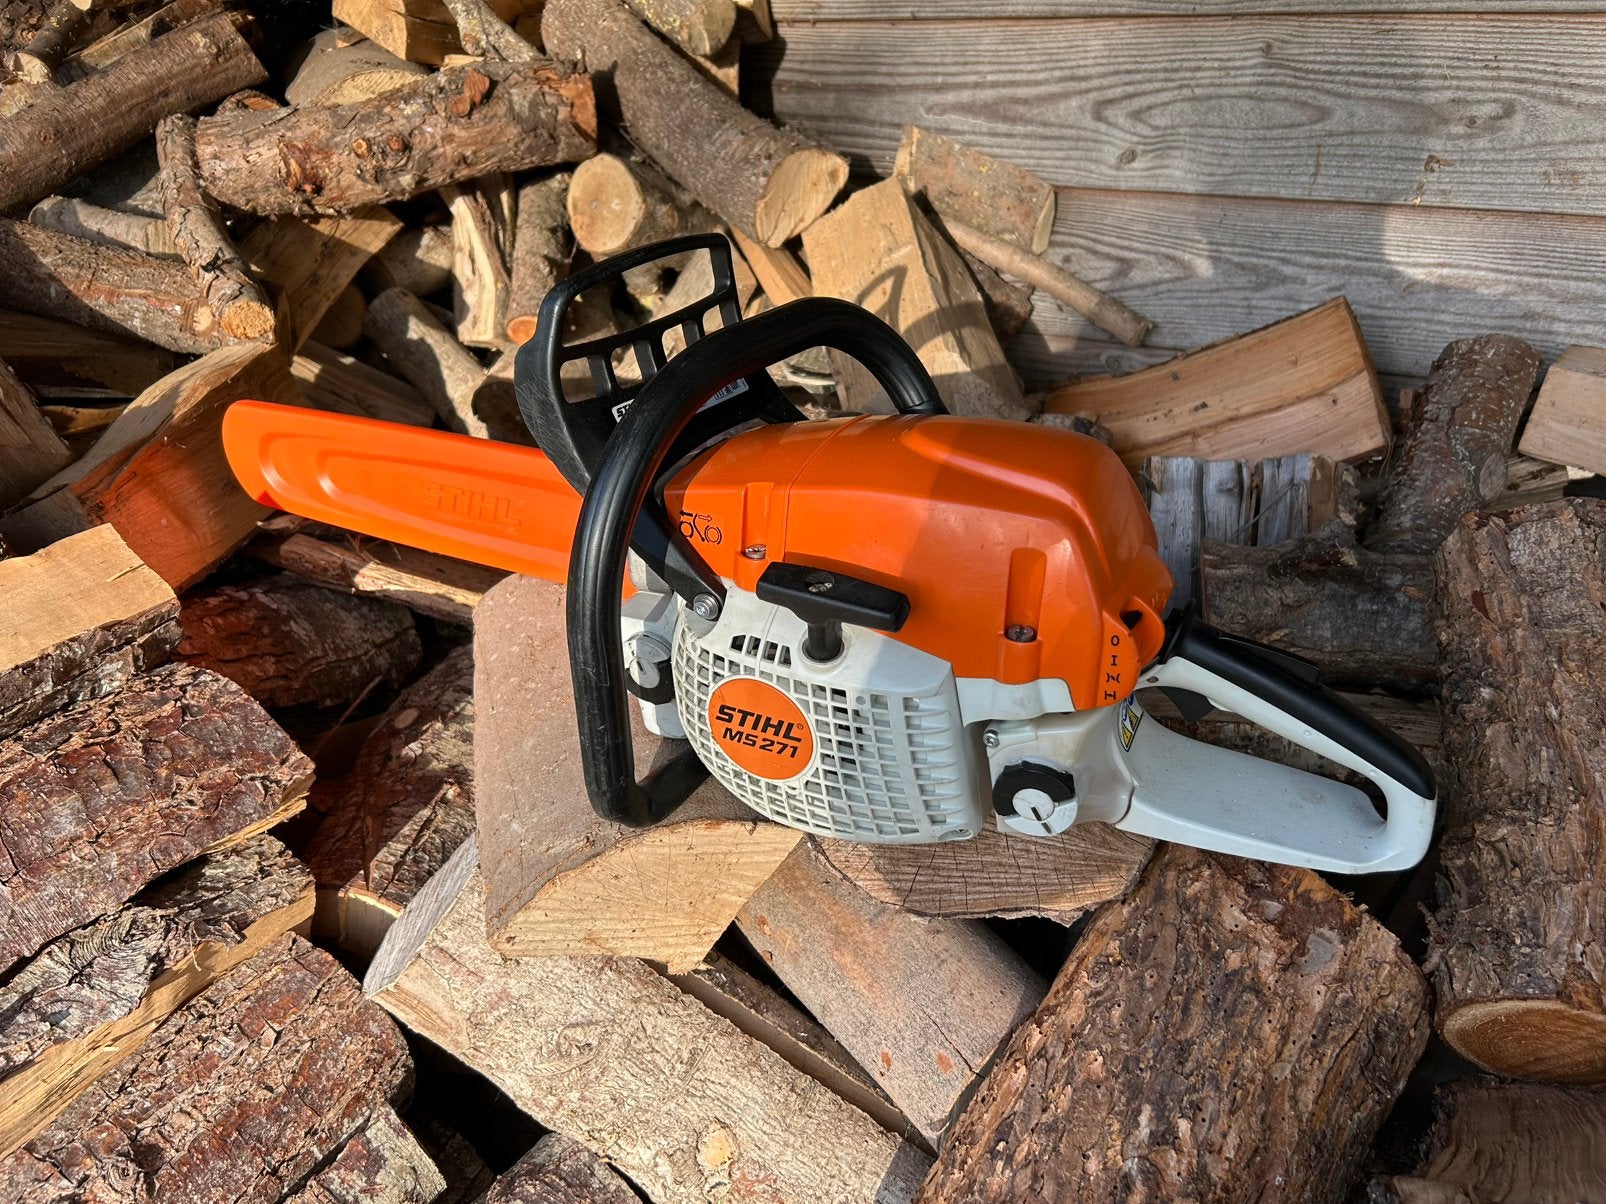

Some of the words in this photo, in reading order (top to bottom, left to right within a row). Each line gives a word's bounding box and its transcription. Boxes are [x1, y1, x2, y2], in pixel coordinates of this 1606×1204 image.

[421, 480, 522, 526] STIHL
[715, 704, 803, 743] STIHL
[722, 726, 759, 748] MS
[758, 737, 799, 759] 271
